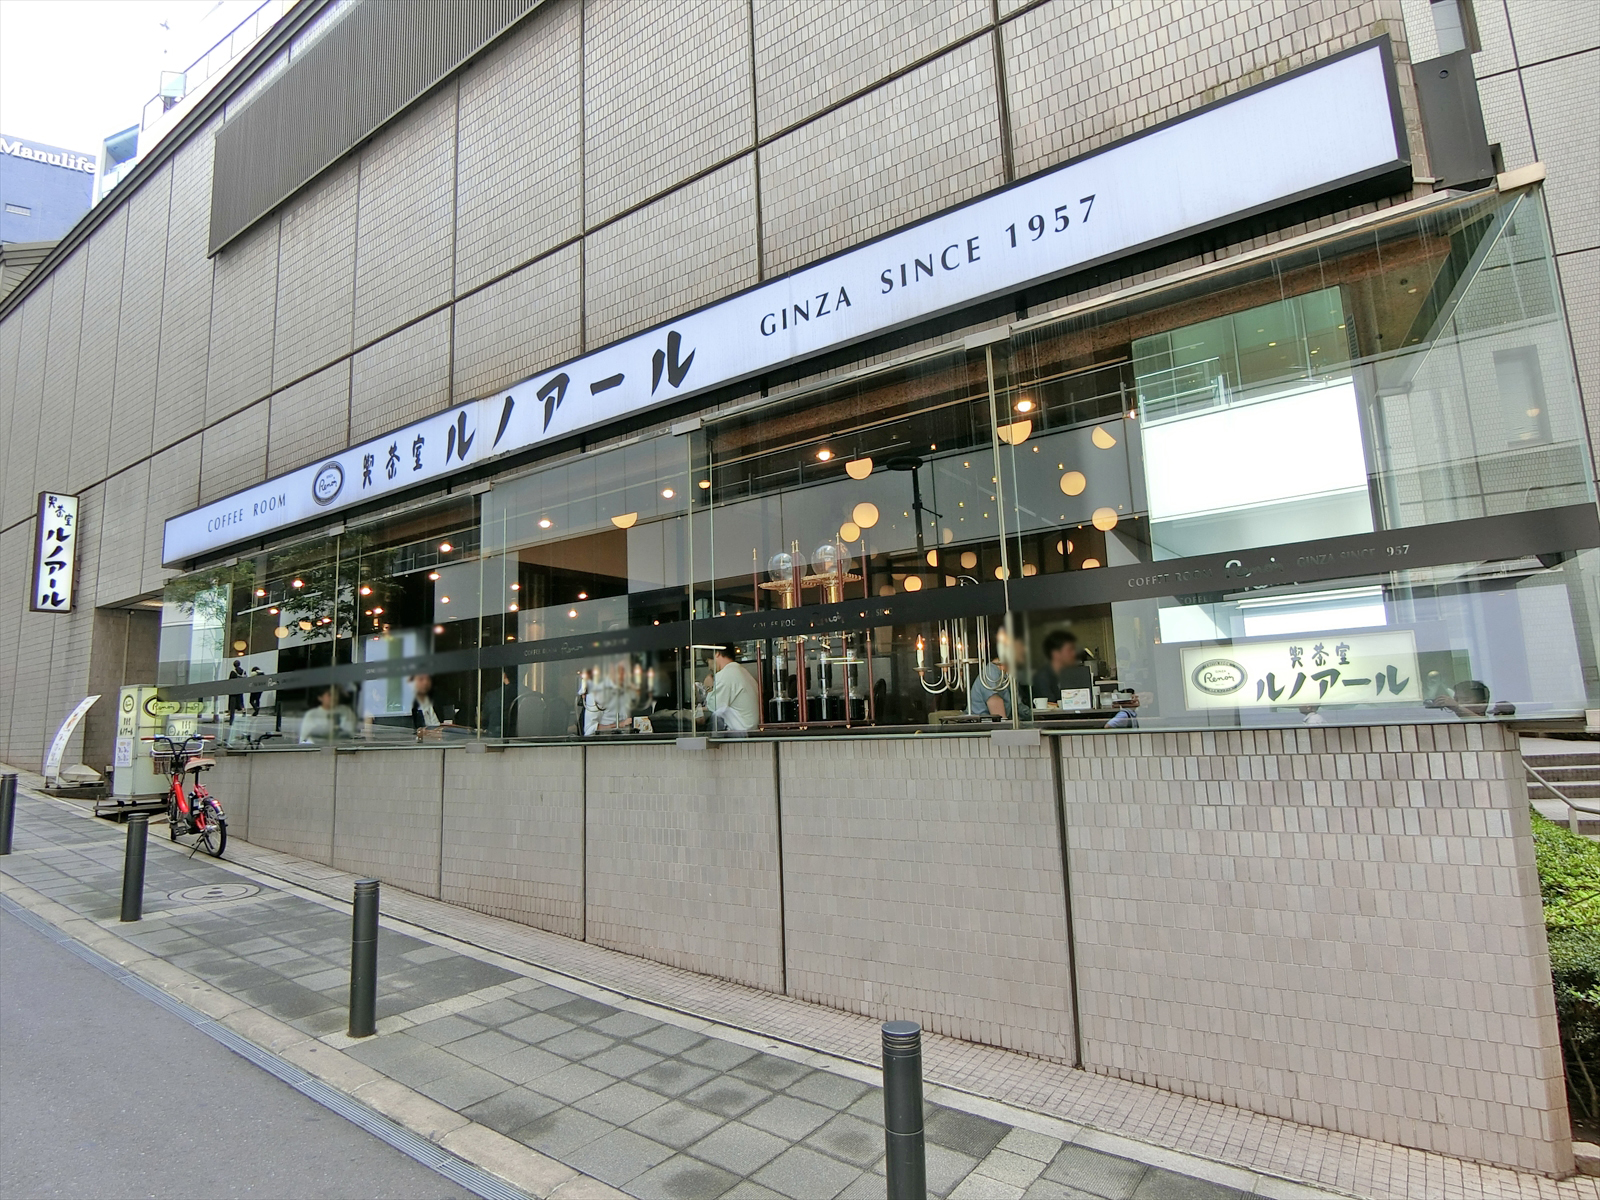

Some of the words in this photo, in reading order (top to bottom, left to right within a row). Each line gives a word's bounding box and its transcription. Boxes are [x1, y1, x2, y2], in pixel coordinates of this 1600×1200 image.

[0, 137, 96, 173] Manulife
[760, 286, 852, 337] GINZA
[880, 236, 982, 294] SINCE
[1005, 194, 1097, 249] 1957
[362, 433, 425, 489] 喫茶室
[445, 330, 697, 466] ルノアール
[207, 508, 244, 533] COFFEE
[253, 493, 286, 517] ROOM
[41, 526, 72, 607] ルノアール
[1289, 642, 1351, 669] 喫茶室
[1256, 664, 1410, 702] ルノアール
